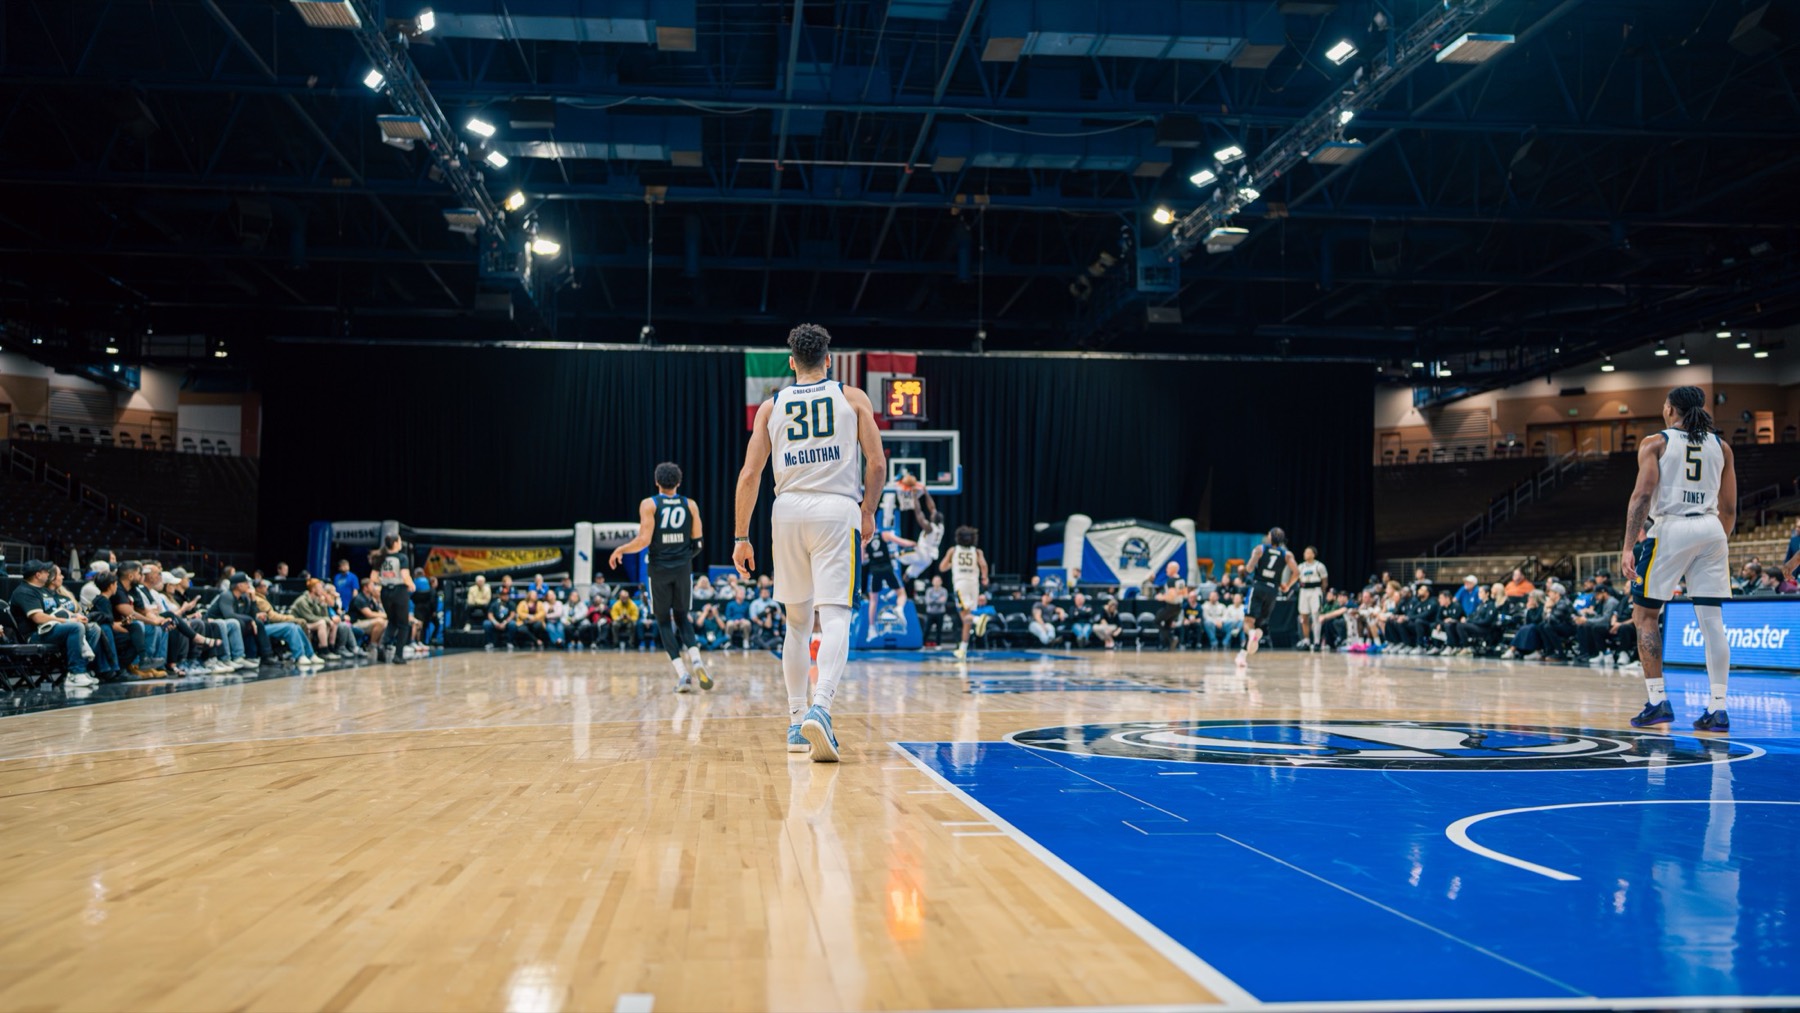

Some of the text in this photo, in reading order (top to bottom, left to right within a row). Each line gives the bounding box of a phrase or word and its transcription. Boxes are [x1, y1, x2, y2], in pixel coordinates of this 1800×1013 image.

[890, 394, 918, 415] 21
[785, 396, 835, 442] 30
[784, 445, 840, 467] Mc GLOTHAN
[1685, 444, 1702, 482] 5
[1683, 490, 1706, 504] TONEY
[660, 506, 686, 529] 10
[336, 529, 376, 540] FINISH
[958, 552, 973, 567] 55
[1267, 555, 1278, 570] 1
[1682, 620, 1790, 648] ticmaster
